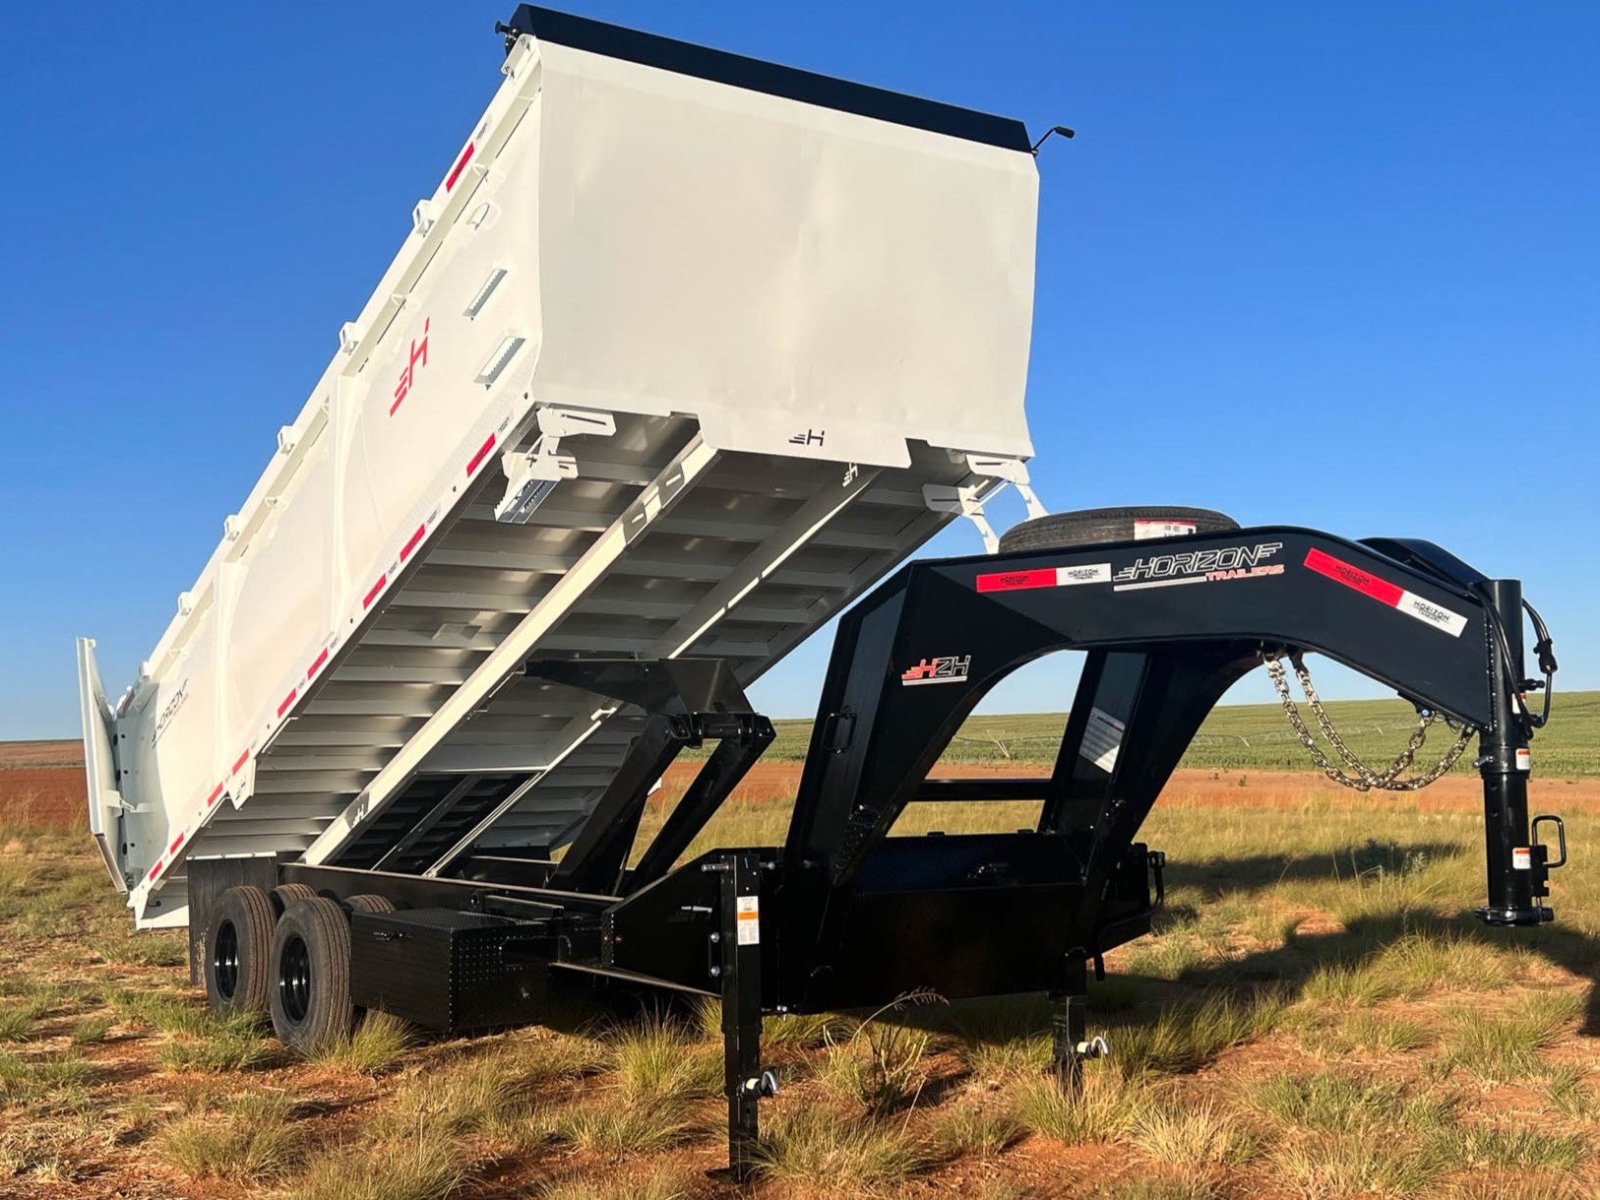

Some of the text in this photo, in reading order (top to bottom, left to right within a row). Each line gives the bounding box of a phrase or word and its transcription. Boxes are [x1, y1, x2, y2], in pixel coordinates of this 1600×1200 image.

[1113, 542, 1283, 582] HORIZON
[1205, 564, 1285, 582] TRAILERS
[1414, 600, 1450, 622] HORIZON
